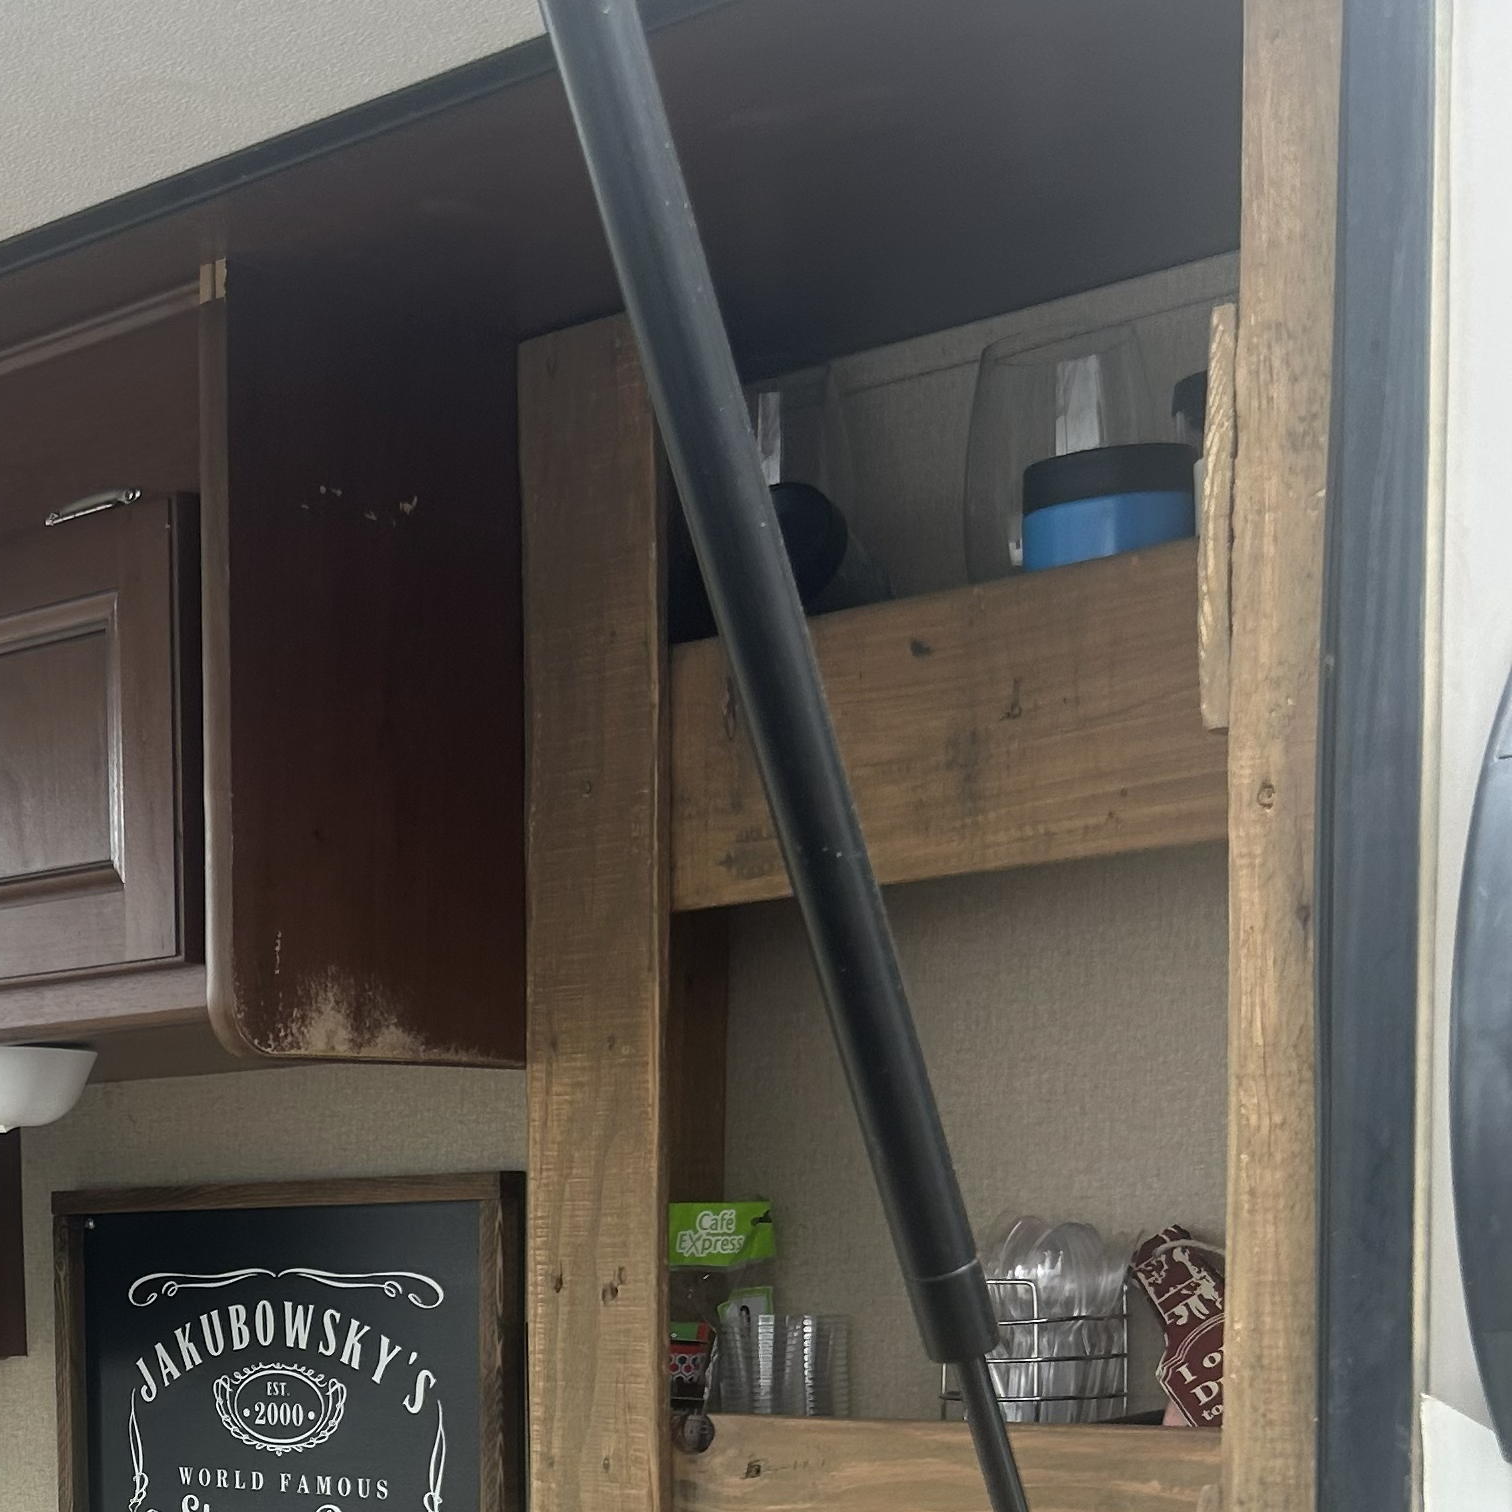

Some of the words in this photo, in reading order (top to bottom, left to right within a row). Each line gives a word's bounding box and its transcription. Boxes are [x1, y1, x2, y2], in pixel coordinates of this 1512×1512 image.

[697, 1210, 735, 1232] Café
[135, 1299, 437, 1414] JAKUBOWSKY'S
[266, 1381, 291, 1397] EST.
[254, 1401, 304, 1427] 2000
[178, 1466, 265, 1491] WORLD
[279, 1472, 389, 1500] FAMOUS
